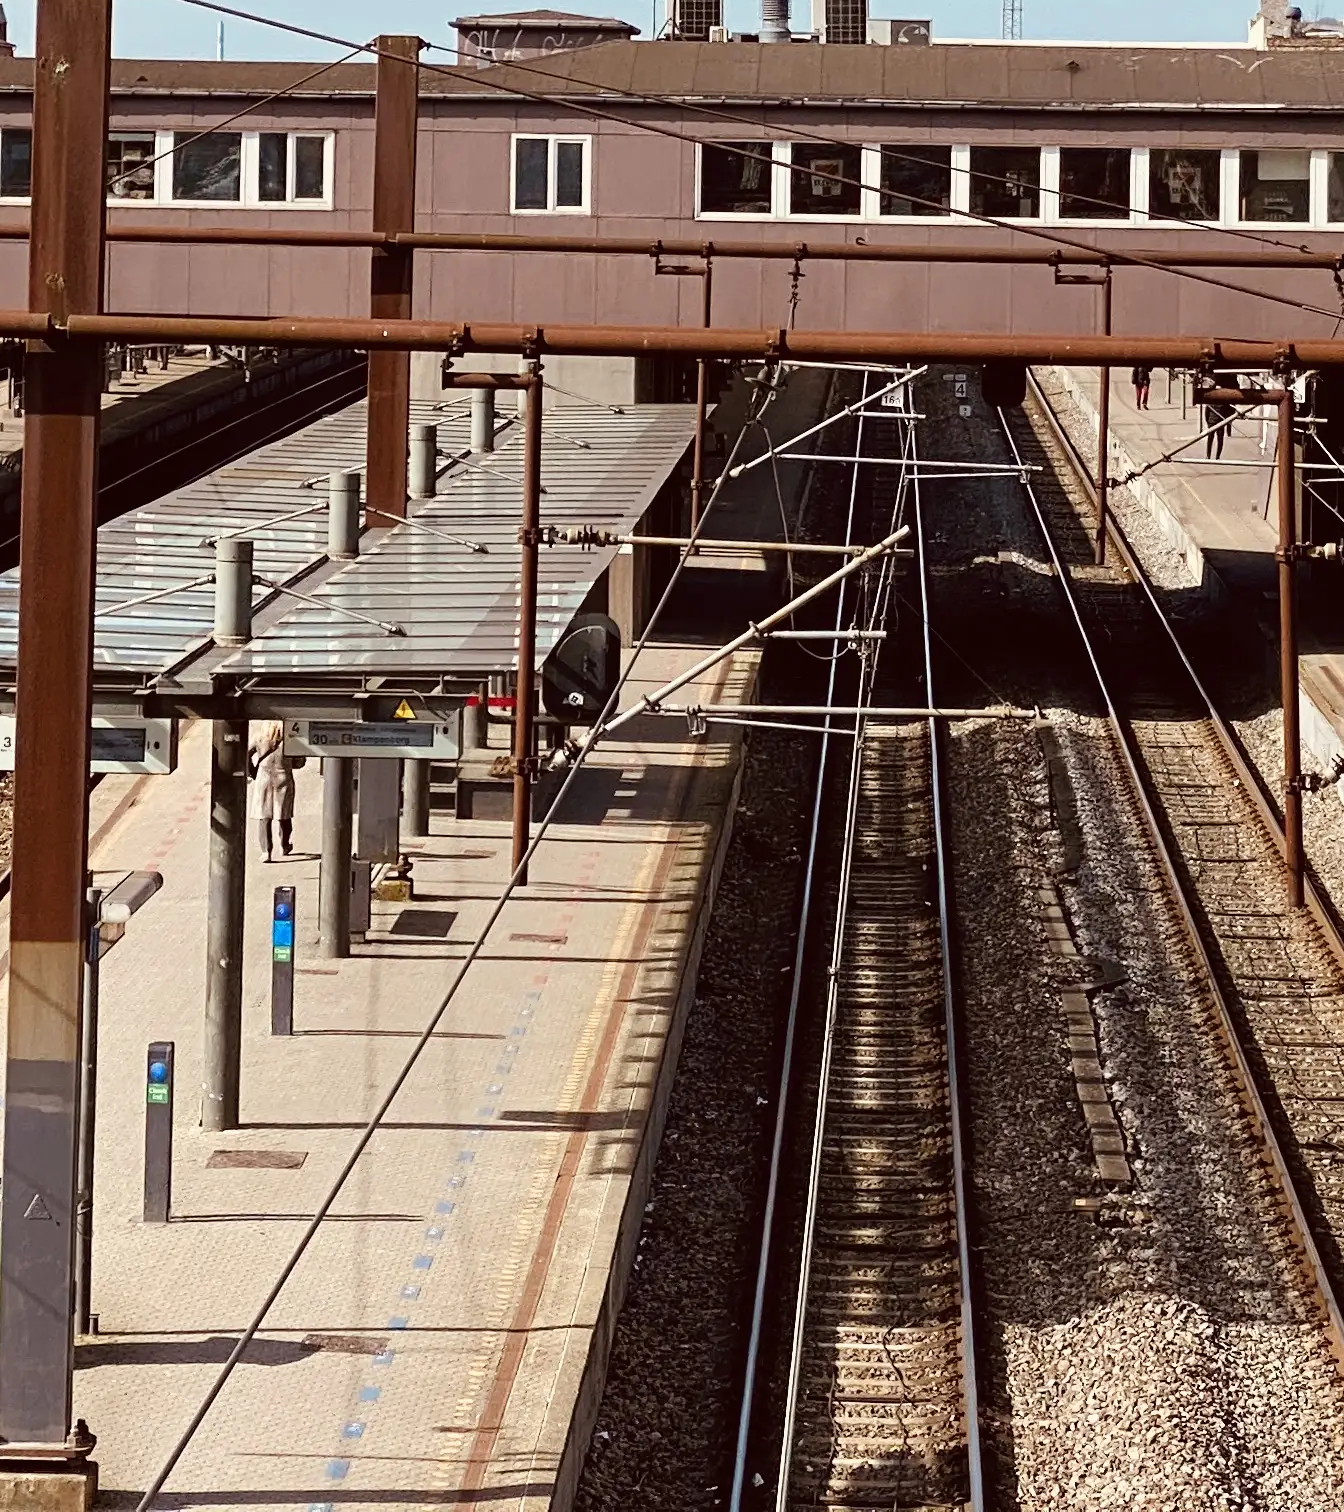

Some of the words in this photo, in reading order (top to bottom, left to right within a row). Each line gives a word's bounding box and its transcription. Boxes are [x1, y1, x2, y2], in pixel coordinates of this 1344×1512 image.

[956, 384, 965, 395] 4
[291, 722, 300, 734] 4
[3, 736, 12, 748] 3
